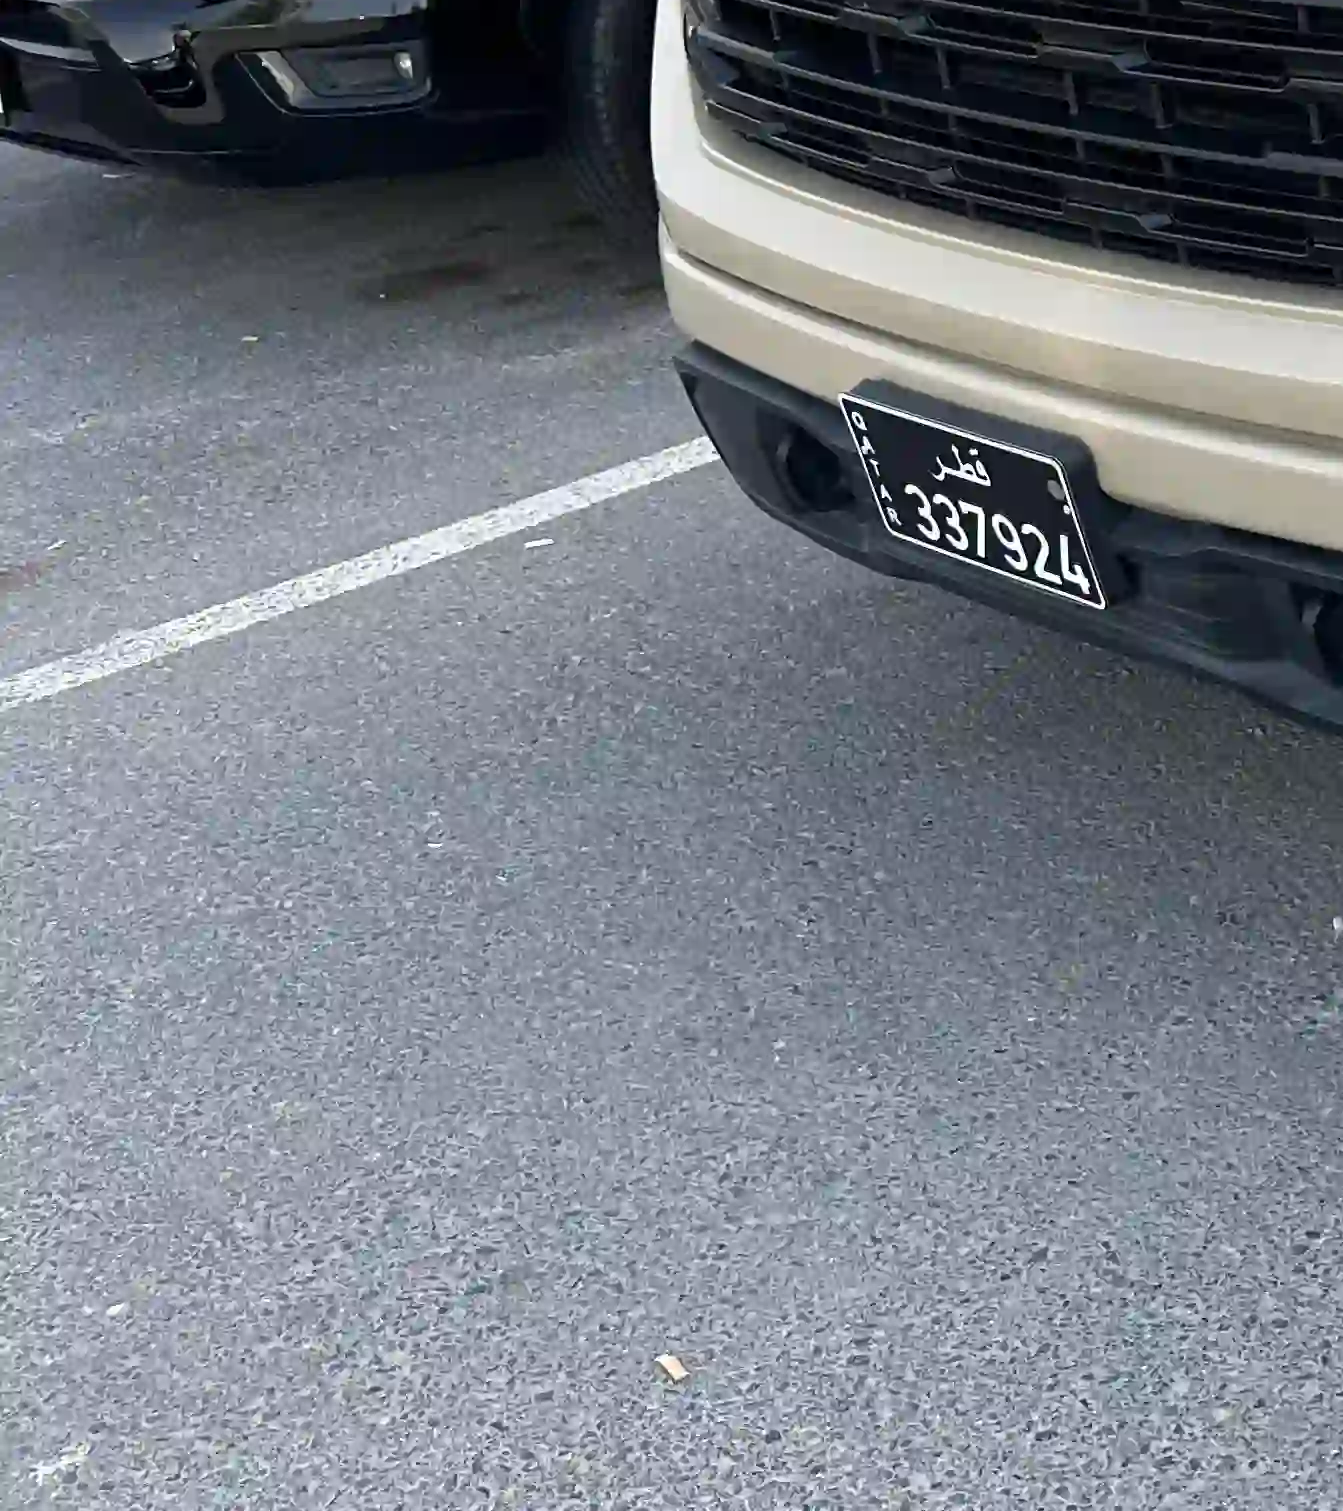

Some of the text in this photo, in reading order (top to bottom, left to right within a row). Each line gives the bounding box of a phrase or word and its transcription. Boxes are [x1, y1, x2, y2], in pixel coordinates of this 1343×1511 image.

[850, 411, 903, 527] QATAR
[928, 443, 992, 487] قطر
[904, 483, 1091, 595] 337924
